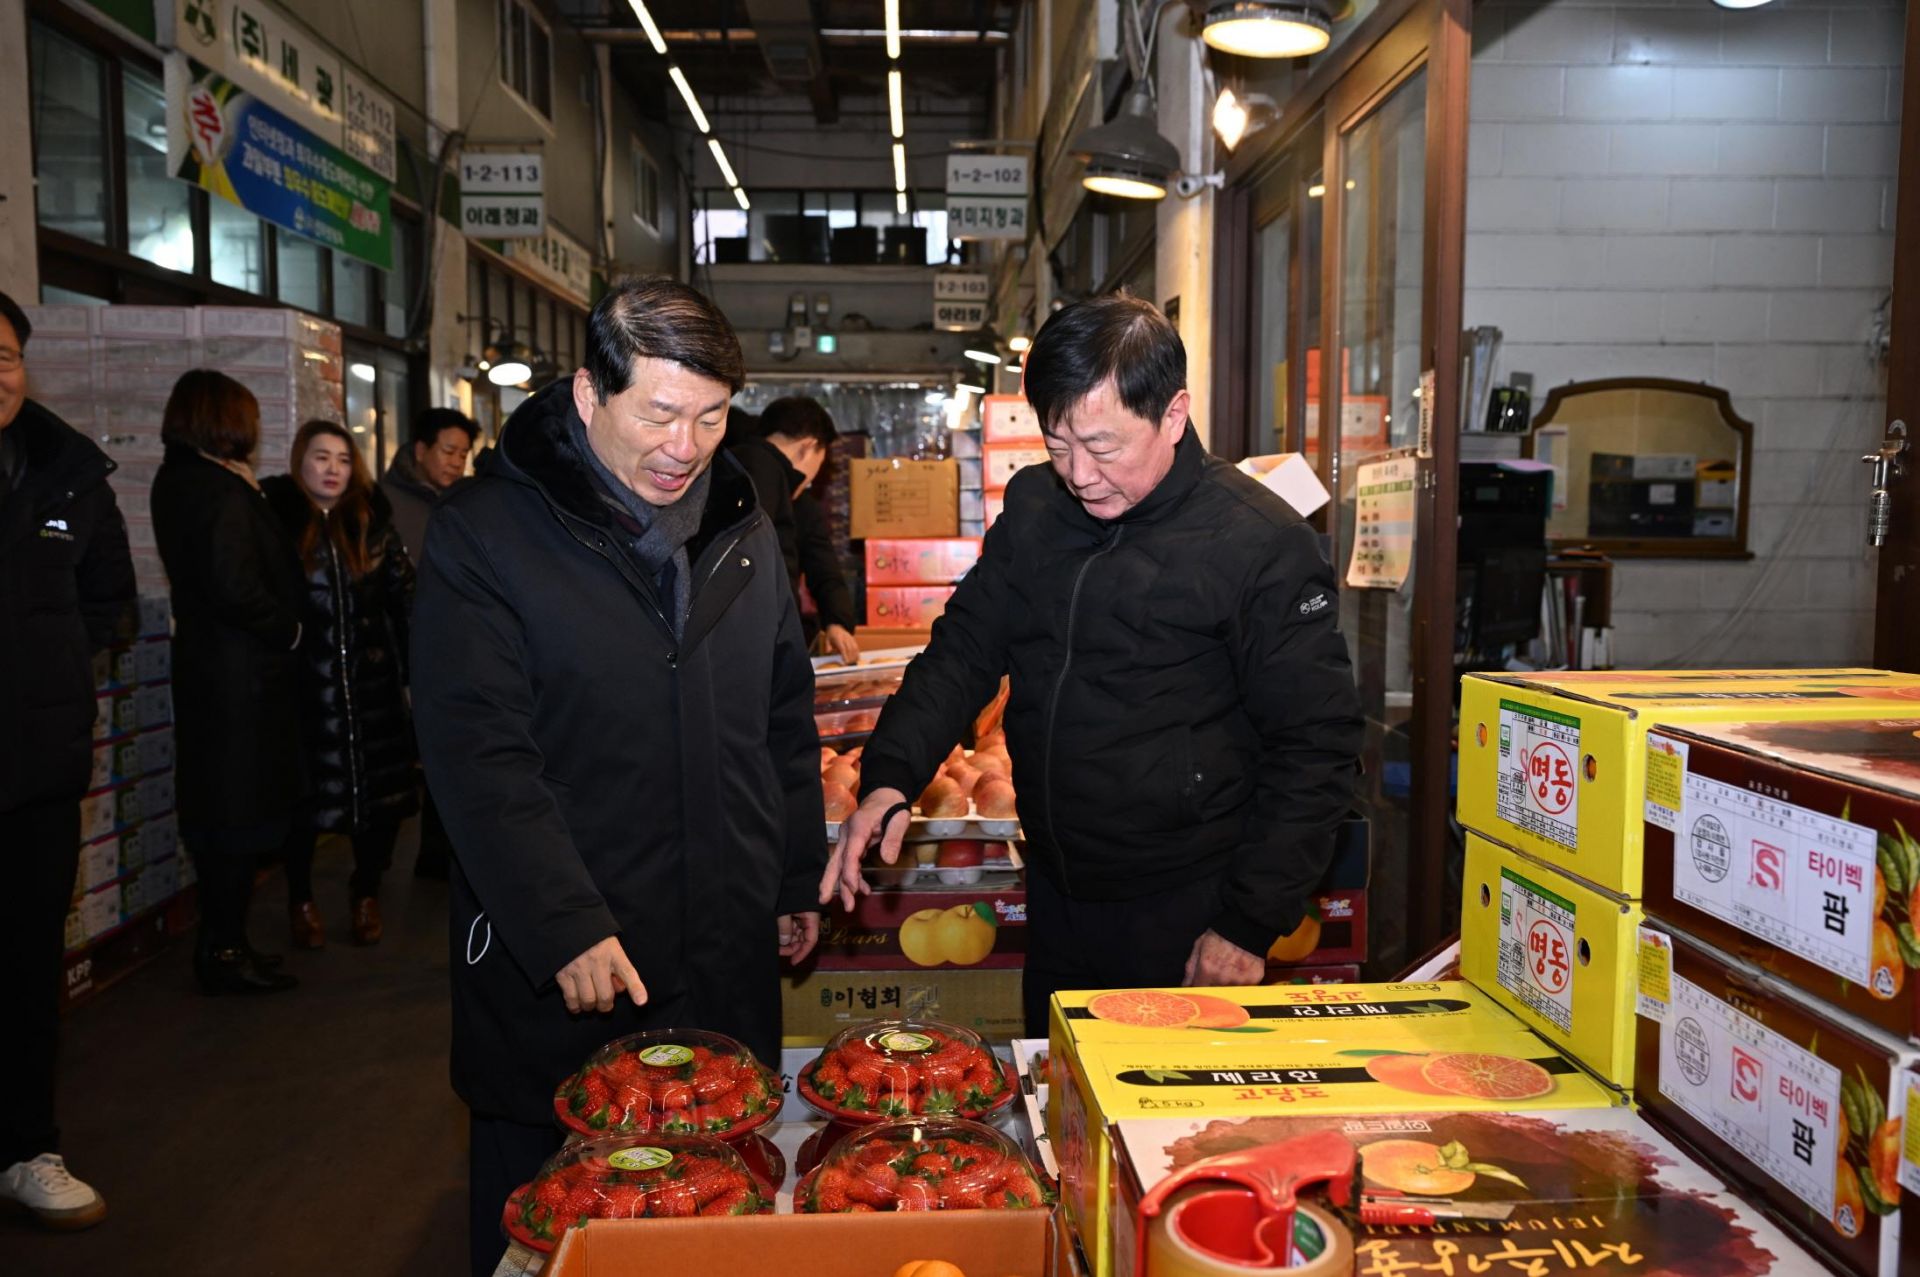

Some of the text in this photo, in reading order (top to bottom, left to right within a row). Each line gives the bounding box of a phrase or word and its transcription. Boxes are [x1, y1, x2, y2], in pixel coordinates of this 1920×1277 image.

[464, 164, 538, 182] 1-2-113
[953, 168, 1022, 183] 1-2-102
[950, 206, 1024, 228] 여미지청과
[938, 280, 986, 293] 1-2-103
[1531, 753, 1572, 806] 명동
[1808, 850, 1862, 894] 타이벡
[1823, 890, 1849, 936] 팜
[67, 959, 93, 986] KPP
[1530, 931, 1568, 987] 명동
[1286, 990, 1366, 1003] 고당도
[1233, 1087, 1329, 1103] 고당도
[1778, 1075, 1828, 1129] 타이벡
[1792, 1117, 1817, 1167] 팜
